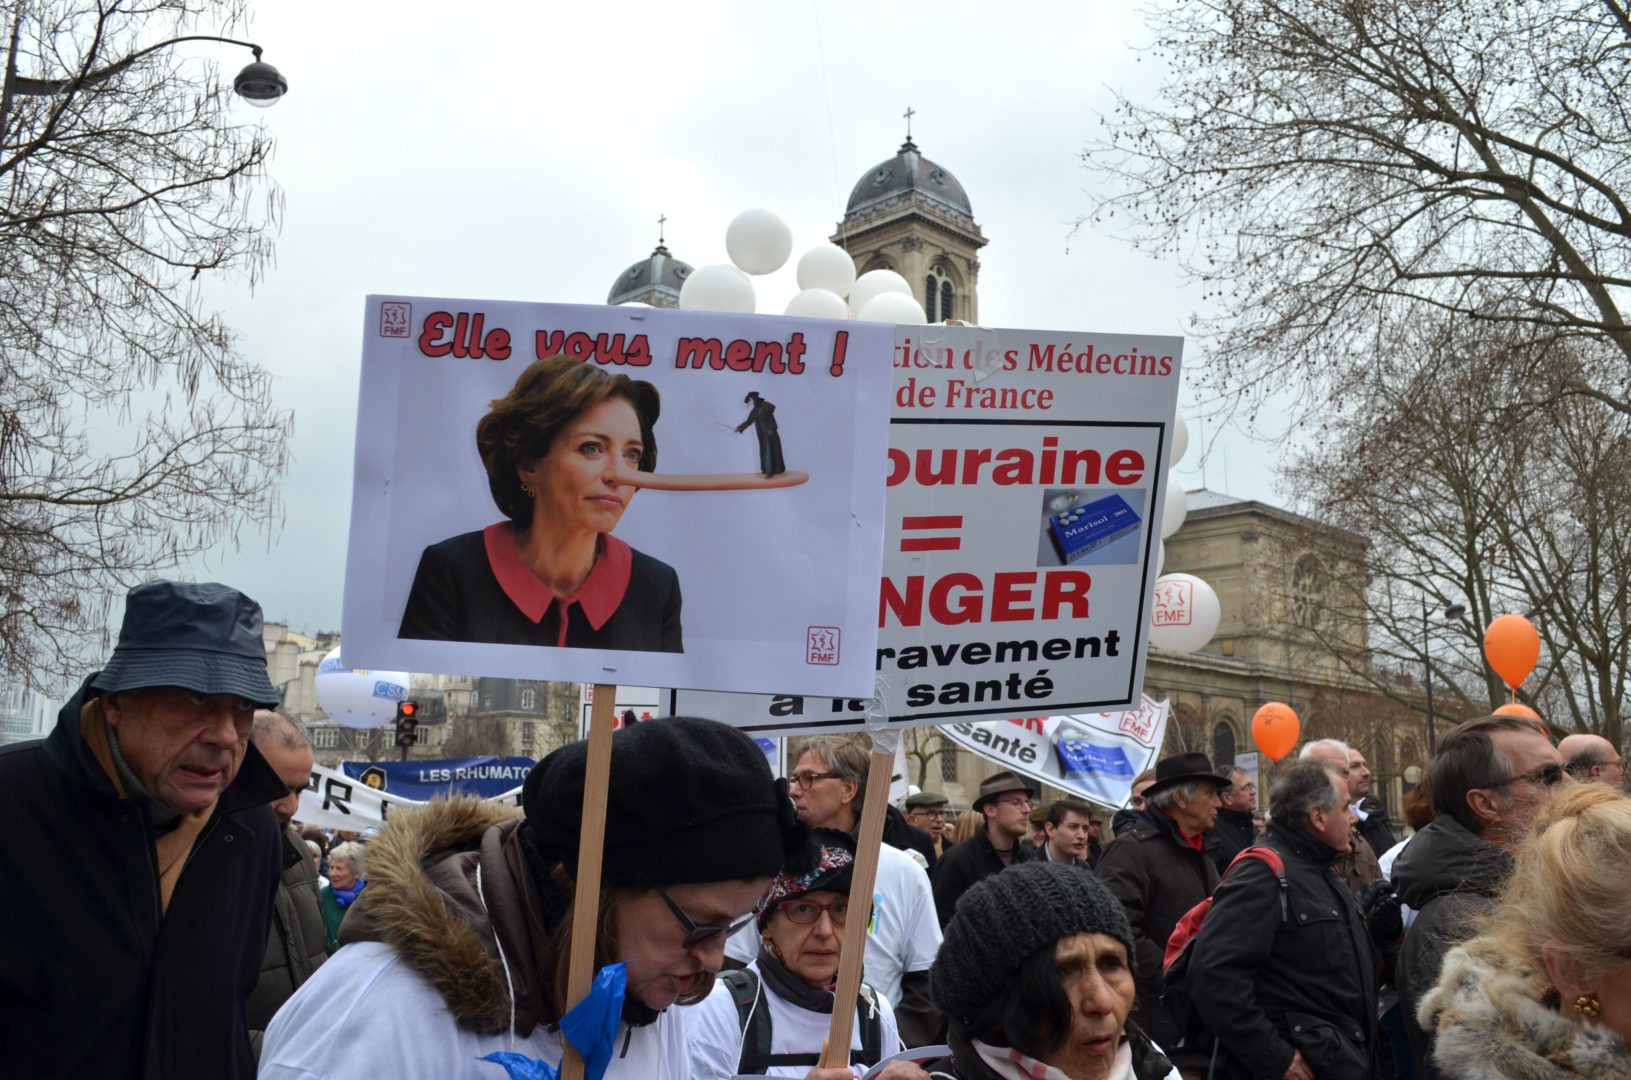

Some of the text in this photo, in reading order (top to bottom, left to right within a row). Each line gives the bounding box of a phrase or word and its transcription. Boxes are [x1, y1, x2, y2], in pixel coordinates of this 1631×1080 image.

[384, 326, 406, 335] FMF
[418, 311, 850, 378] Elle vous ment !
[1027, 342, 1173, 377] Médecins
[896, 377, 1054, 410] de France
[1065, 515, 1108, 538] Marisol
[878, 570, 1092, 628] NGER
[1156, 610, 1185, 622] FMF
[811, 653, 834, 662] FMF
[906, 669, 1054, 708] santé
[1123, 718, 1148, 737] FMF
[953, 722, 1037, 764] santé
[420, 769, 451, 782] LES
